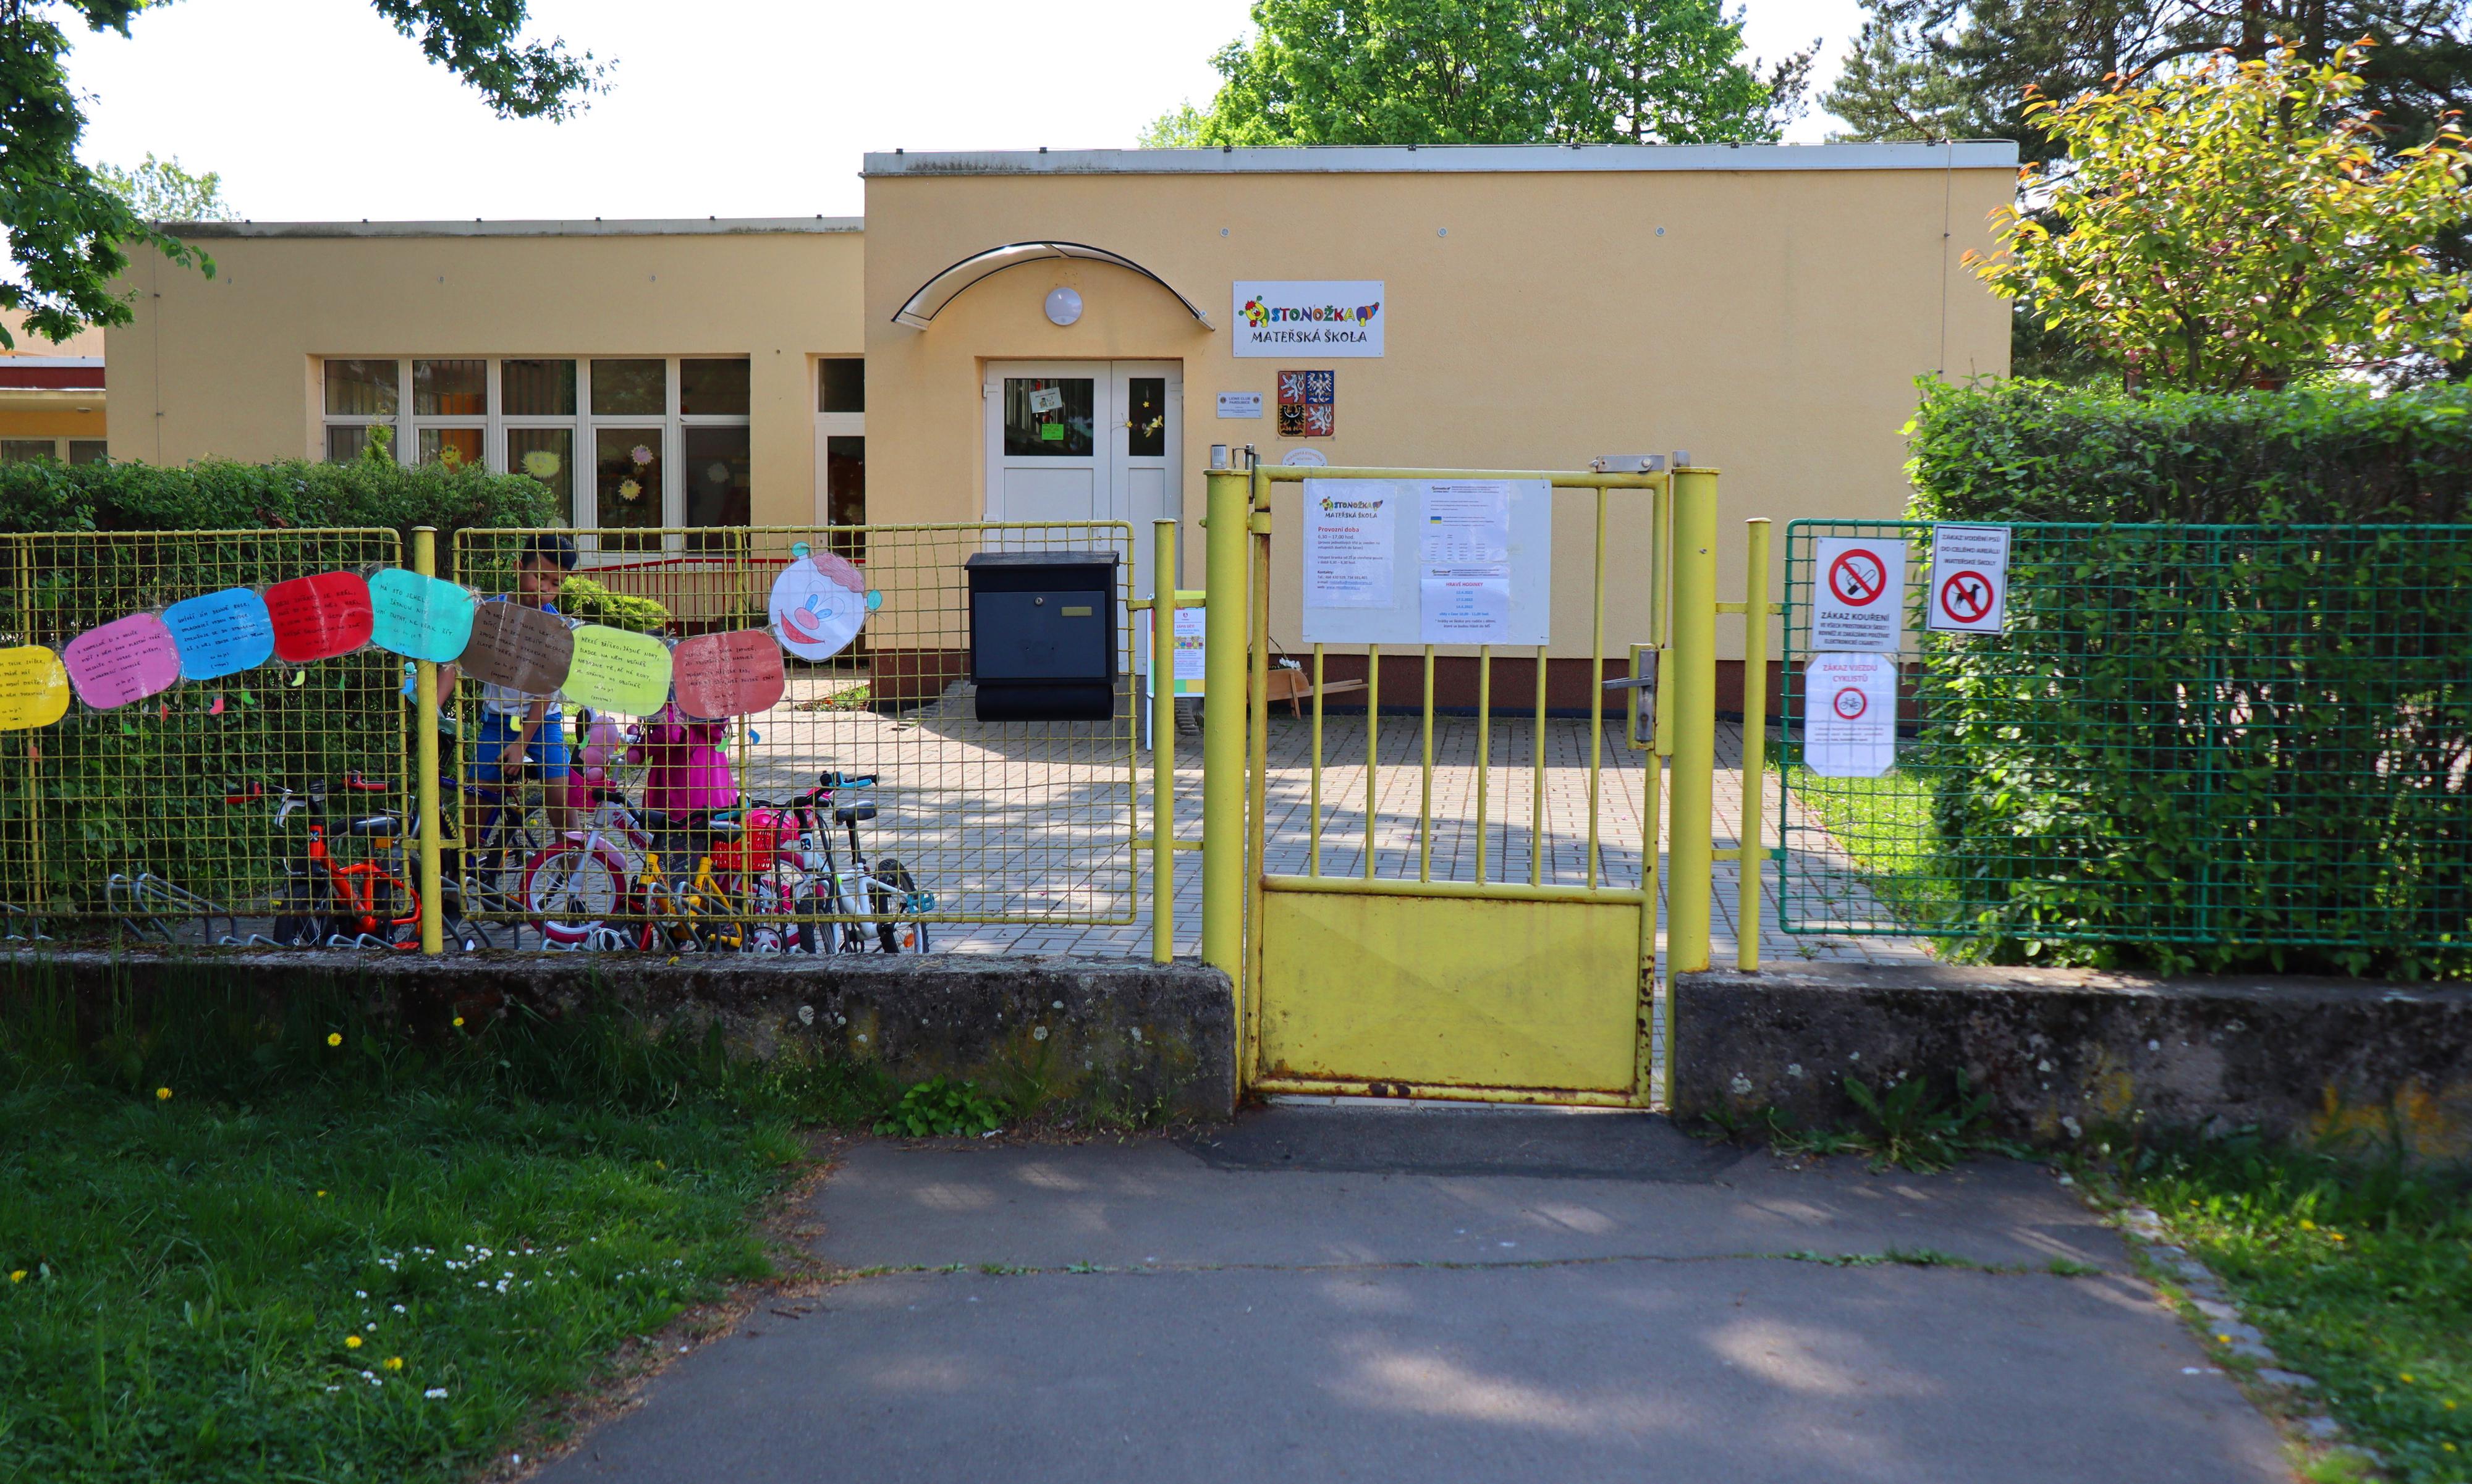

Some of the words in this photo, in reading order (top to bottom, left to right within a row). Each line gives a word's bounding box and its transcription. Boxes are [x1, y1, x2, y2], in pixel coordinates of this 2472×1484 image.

[1271, 305, 1355, 323] STONOŽKA
[1250, 329, 1321, 343] MATEŘSKÁ
[1324, 329, 1367, 342] ŠKOLA
[1821, 611, 1850, 620] ZÁKAZ
[1852, 613, 1889, 621] KOUŘENÍ
